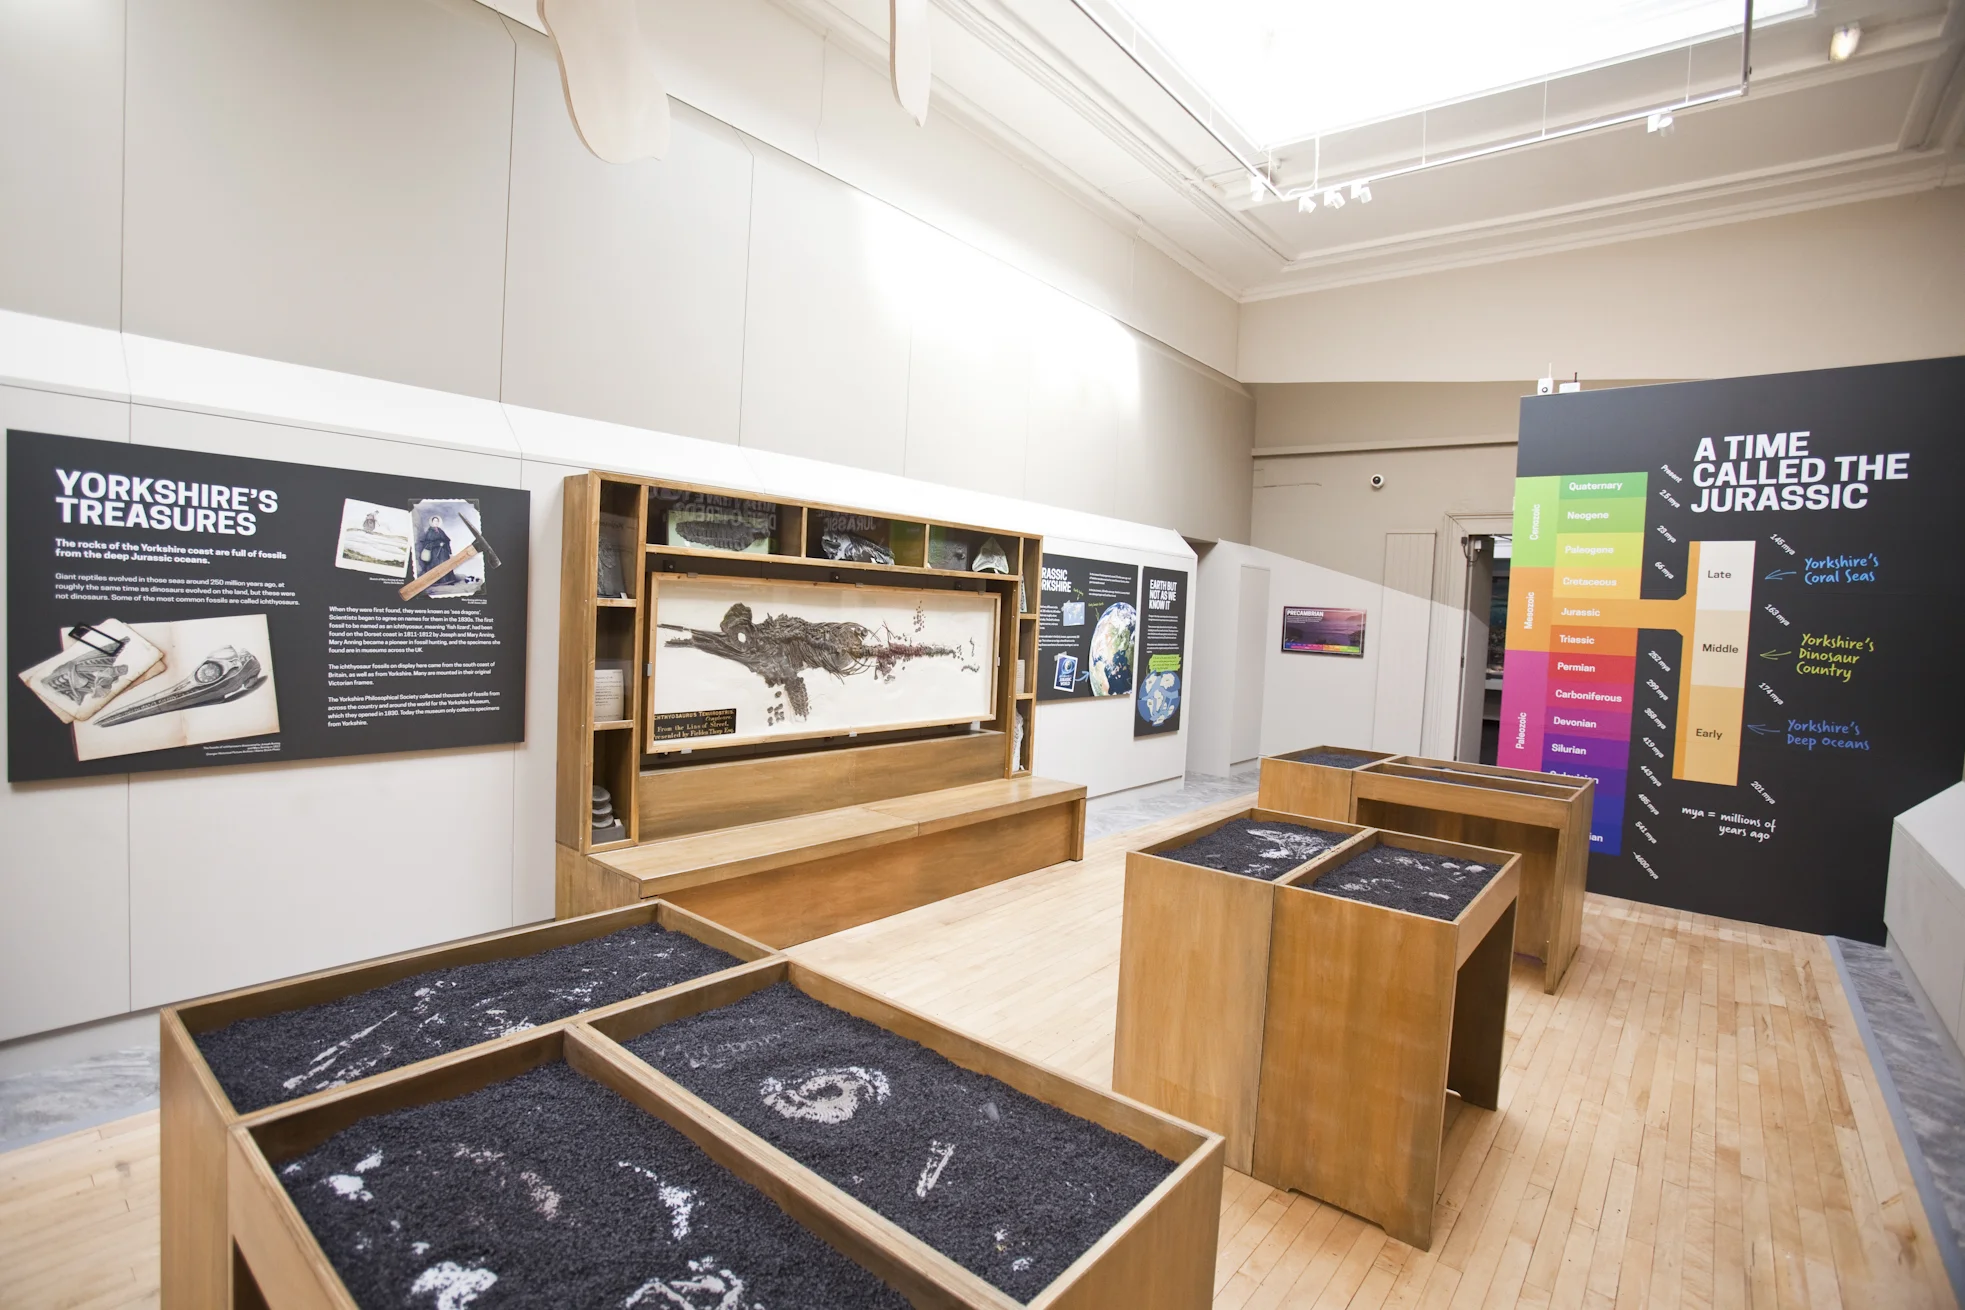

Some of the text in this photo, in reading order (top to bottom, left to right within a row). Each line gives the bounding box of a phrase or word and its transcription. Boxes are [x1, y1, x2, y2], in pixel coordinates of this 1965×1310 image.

[1694, 431, 1810, 461] A TIME
[1661, 464, 1682, 483] Present
[1693, 453, 1910, 487] CALLED THE
[55, 469, 278, 513] YORKSHIRE'S
[1569, 482, 1623, 491] Quaternary
[1659, 489, 1680, 508] 2.5 mya
[1691, 483, 1868, 513] JURASSIC
[55, 496, 257, 536] TREASURES
[1530, 504, 1541, 540] Cenozoic
[1568, 511, 1609, 521] Neogene
[1657, 525, 1676, 543] 23 mya
[55, 538, 76, 547] The
[78, 540, 107, 550] rocks
[109, 542, 120, 550] of
[122, 543, 139, 551] the
[141, 543, 186, 553] Yorkshire
[231, 549, 246, 557] full
[248, 550, 257, 558] of
[258, 550, 287, 560] fossils
[1565, 546, 1614, 555] Paleogene
[1770, 533, 1796, 555] 145 mya
[55, 549, 210, 564] from the deep Jurassic oceans.
[1805, 553, 1879, 571] Yorkshire's
[78, 574, 107, 582] reptiles
[1042, 567, 1067, 580] RASSIC
[1655, 562, 1674, 579] 66 mya
[1707, 570, 1731, 579] Late
[1805, 569, 1875, 585] Coral Seas
[1041, 578, 1072, 593] RKSHIRE
[1150, 580, 1177, 590] EARTH BUT
[1563, 577, 1617, 586] Cretaceous
[1149, 590, 1176, 601] NOT AS WE
[1149, 600, 1171, 610] KNOW IT
[1524, 592, 1534, 629] Mesozoic
[1561, 608, 1600, 617] Jurassic
[1765, 604, 1790, 627] 163 mya
[1560, 634, 1595, 644] Triassic
[1801, 633, 1875, 652] Yorkshire's
[1702, 644, 1739, 653] Middle
[1799, 648, 1860, 664] Dinosaur
[1557, 662, 1595, 672] Permian
[1648, 651, 1671, 672] 252 mya
[1796, 662, 1852, 683] Country
[1555, 689, 1622, 702] Carboniferous
[1646, 679, 1669, 700] 299 mya
[1759, 682, 1784, 706] 174 mya
[654, 712, 697, 720] CHTHYOSAURUS
[1553, 716, 1597, 728] Devonian
[1644, 708, 1666, 730] 358 mya
[1515, 712, 1526, 749] Paleozoic
[1696, 728, 1723, 740] Early
[1787, 719, 1861, 735] Yorkshire's
[1551, 744, 1586, 755] Silurian
[1643, 737, 1664, 758] 419 mya
[1787, 734, 1816, 750] Deep
[1641, 765, 1662, 787] 443 mya
[1751, 781, 1776, 805] 201 mya
[1638, 794, 1659, 816] 485 mya
[1682, 807, 1704, 819] mya
[1720, 813, 1761, 827] millions
[1764, 819, 1776, 832] of
[1635, 821, 1657, 844] 541 mya
[1718, 825, 1770, 843] years ago
[1646, 866, 1659, 880] mya
